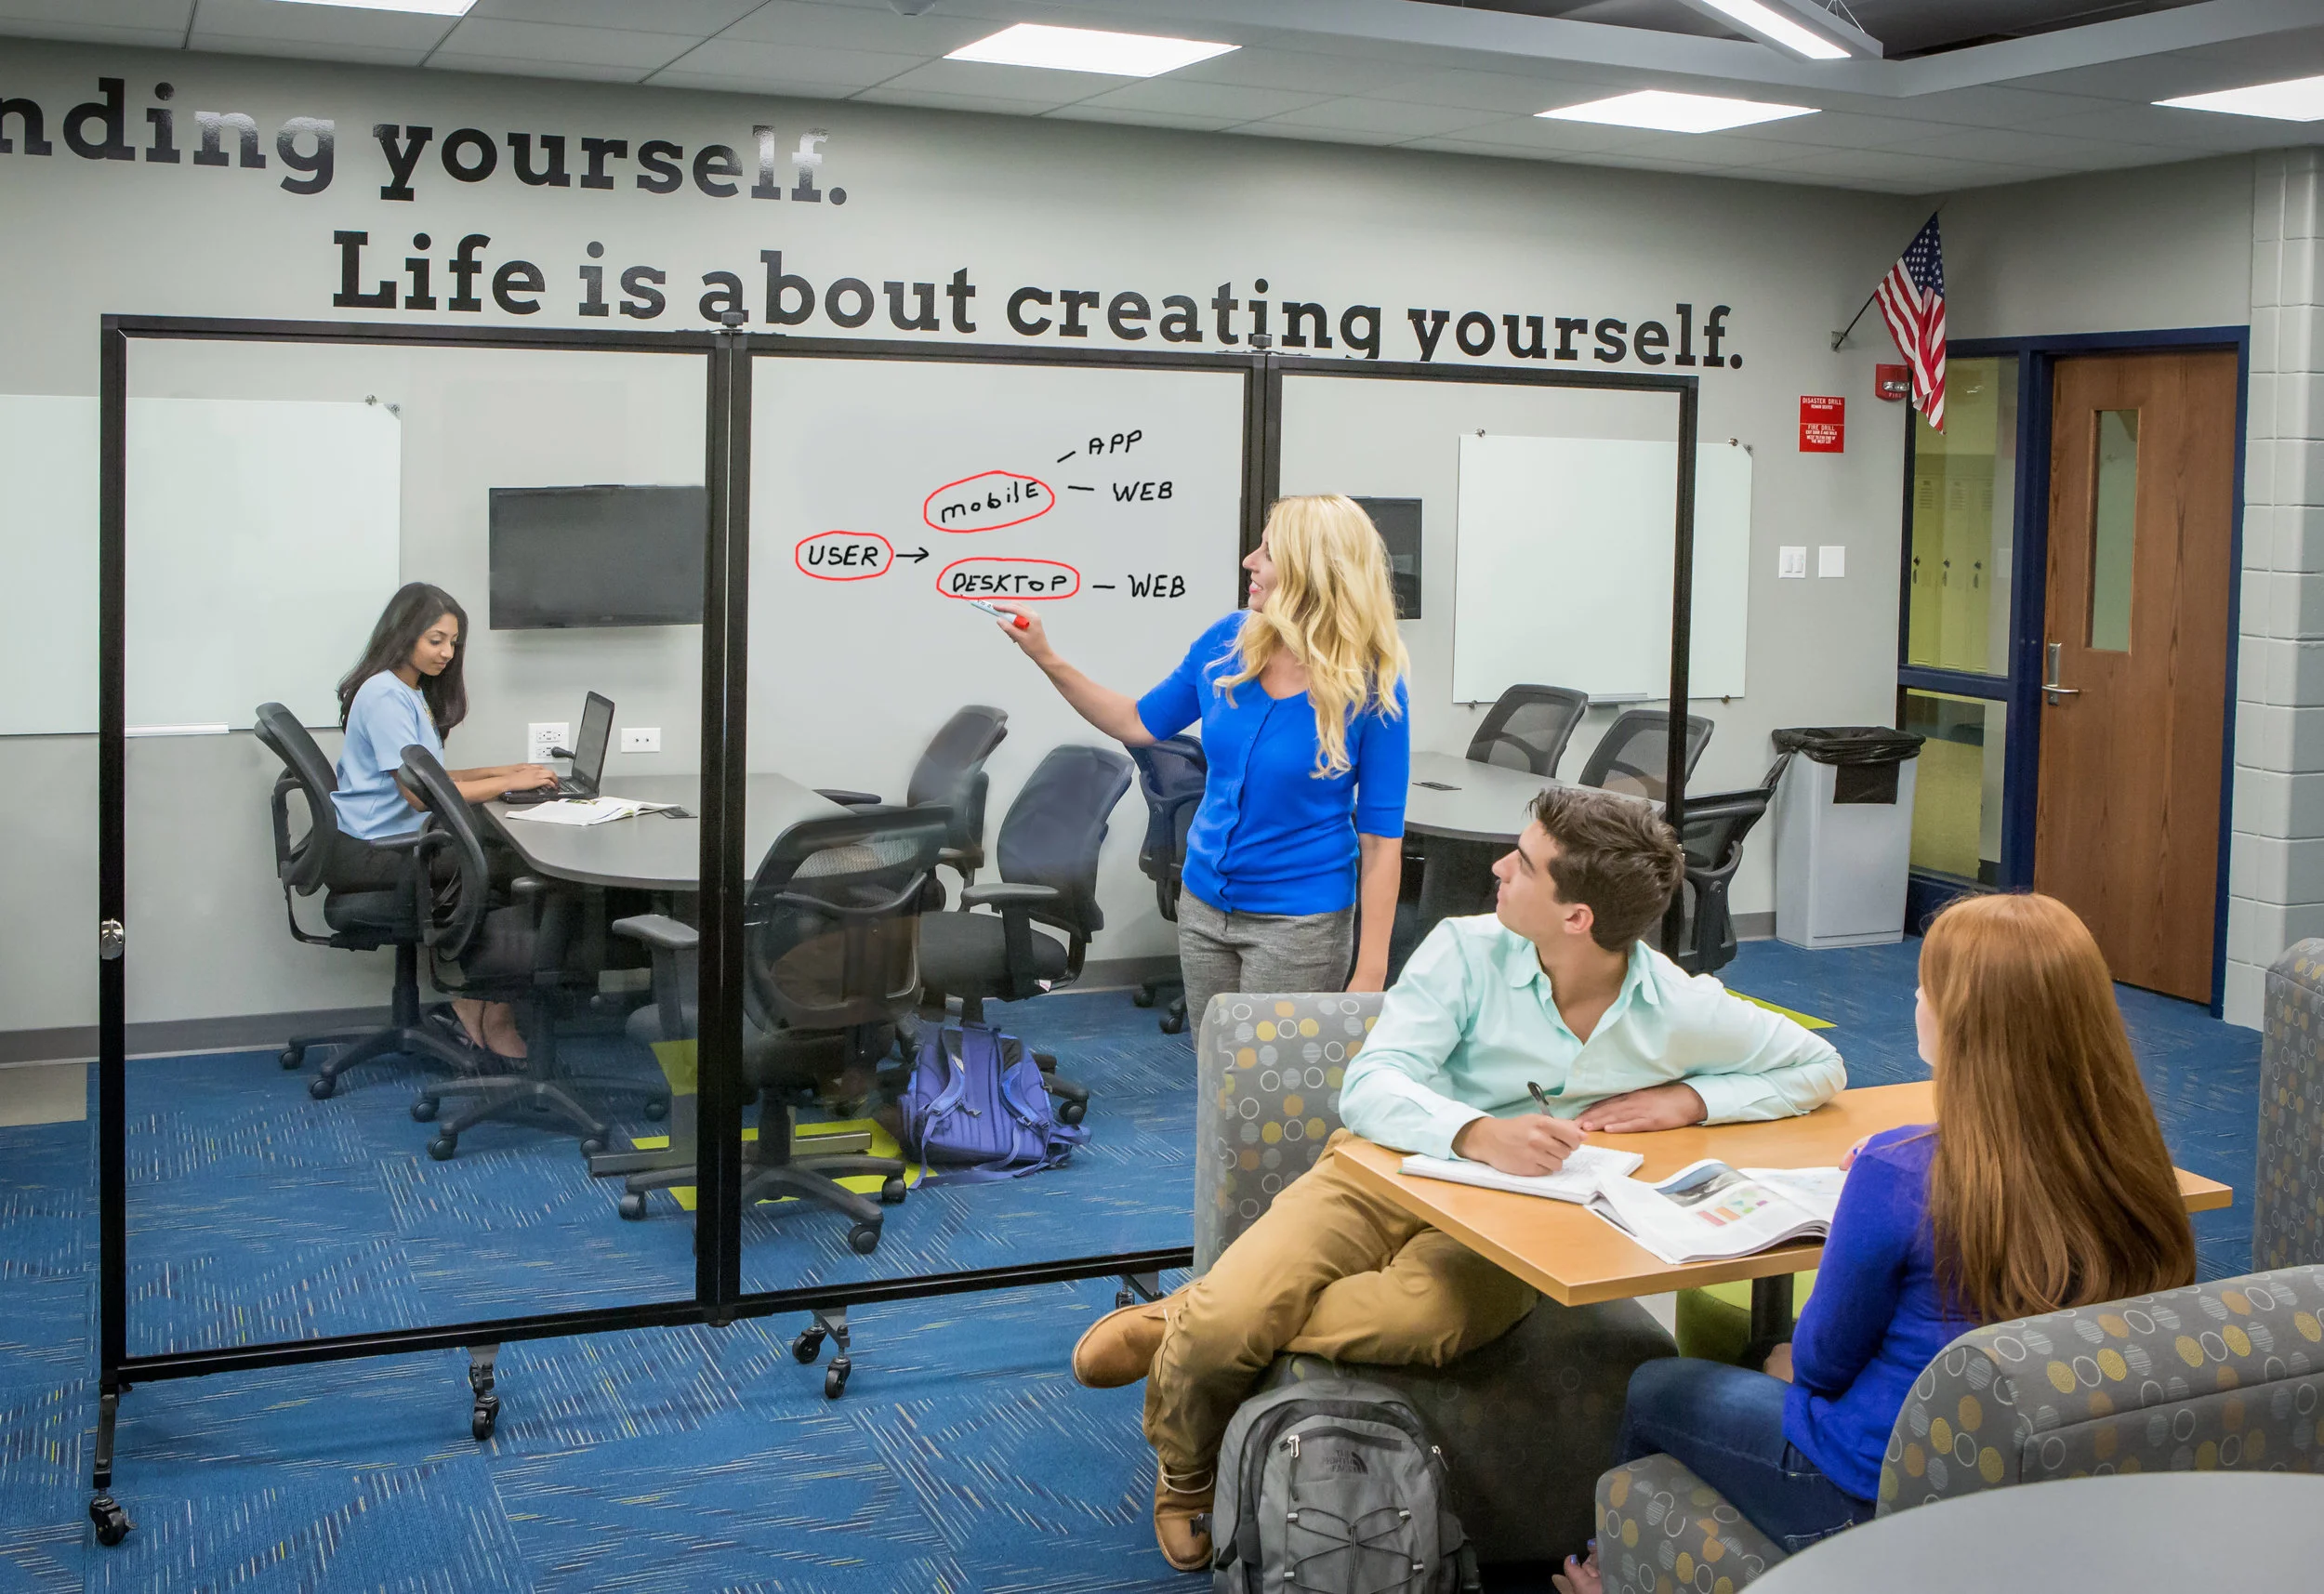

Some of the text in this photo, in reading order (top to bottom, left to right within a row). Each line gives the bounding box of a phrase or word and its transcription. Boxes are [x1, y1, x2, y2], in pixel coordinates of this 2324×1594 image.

[372, 123, 847, 205] yourself.
[333, 230, 1744, 371] Life is about creating yourself.
[1089, 429, 1142, 455] APP
[1113, 481, 1173, 503] WEB
[808, 544, 878, 567] USER
[952, 573, 1067, 594] DESKTOP
[1128, 573, 1186, 599] WEB
